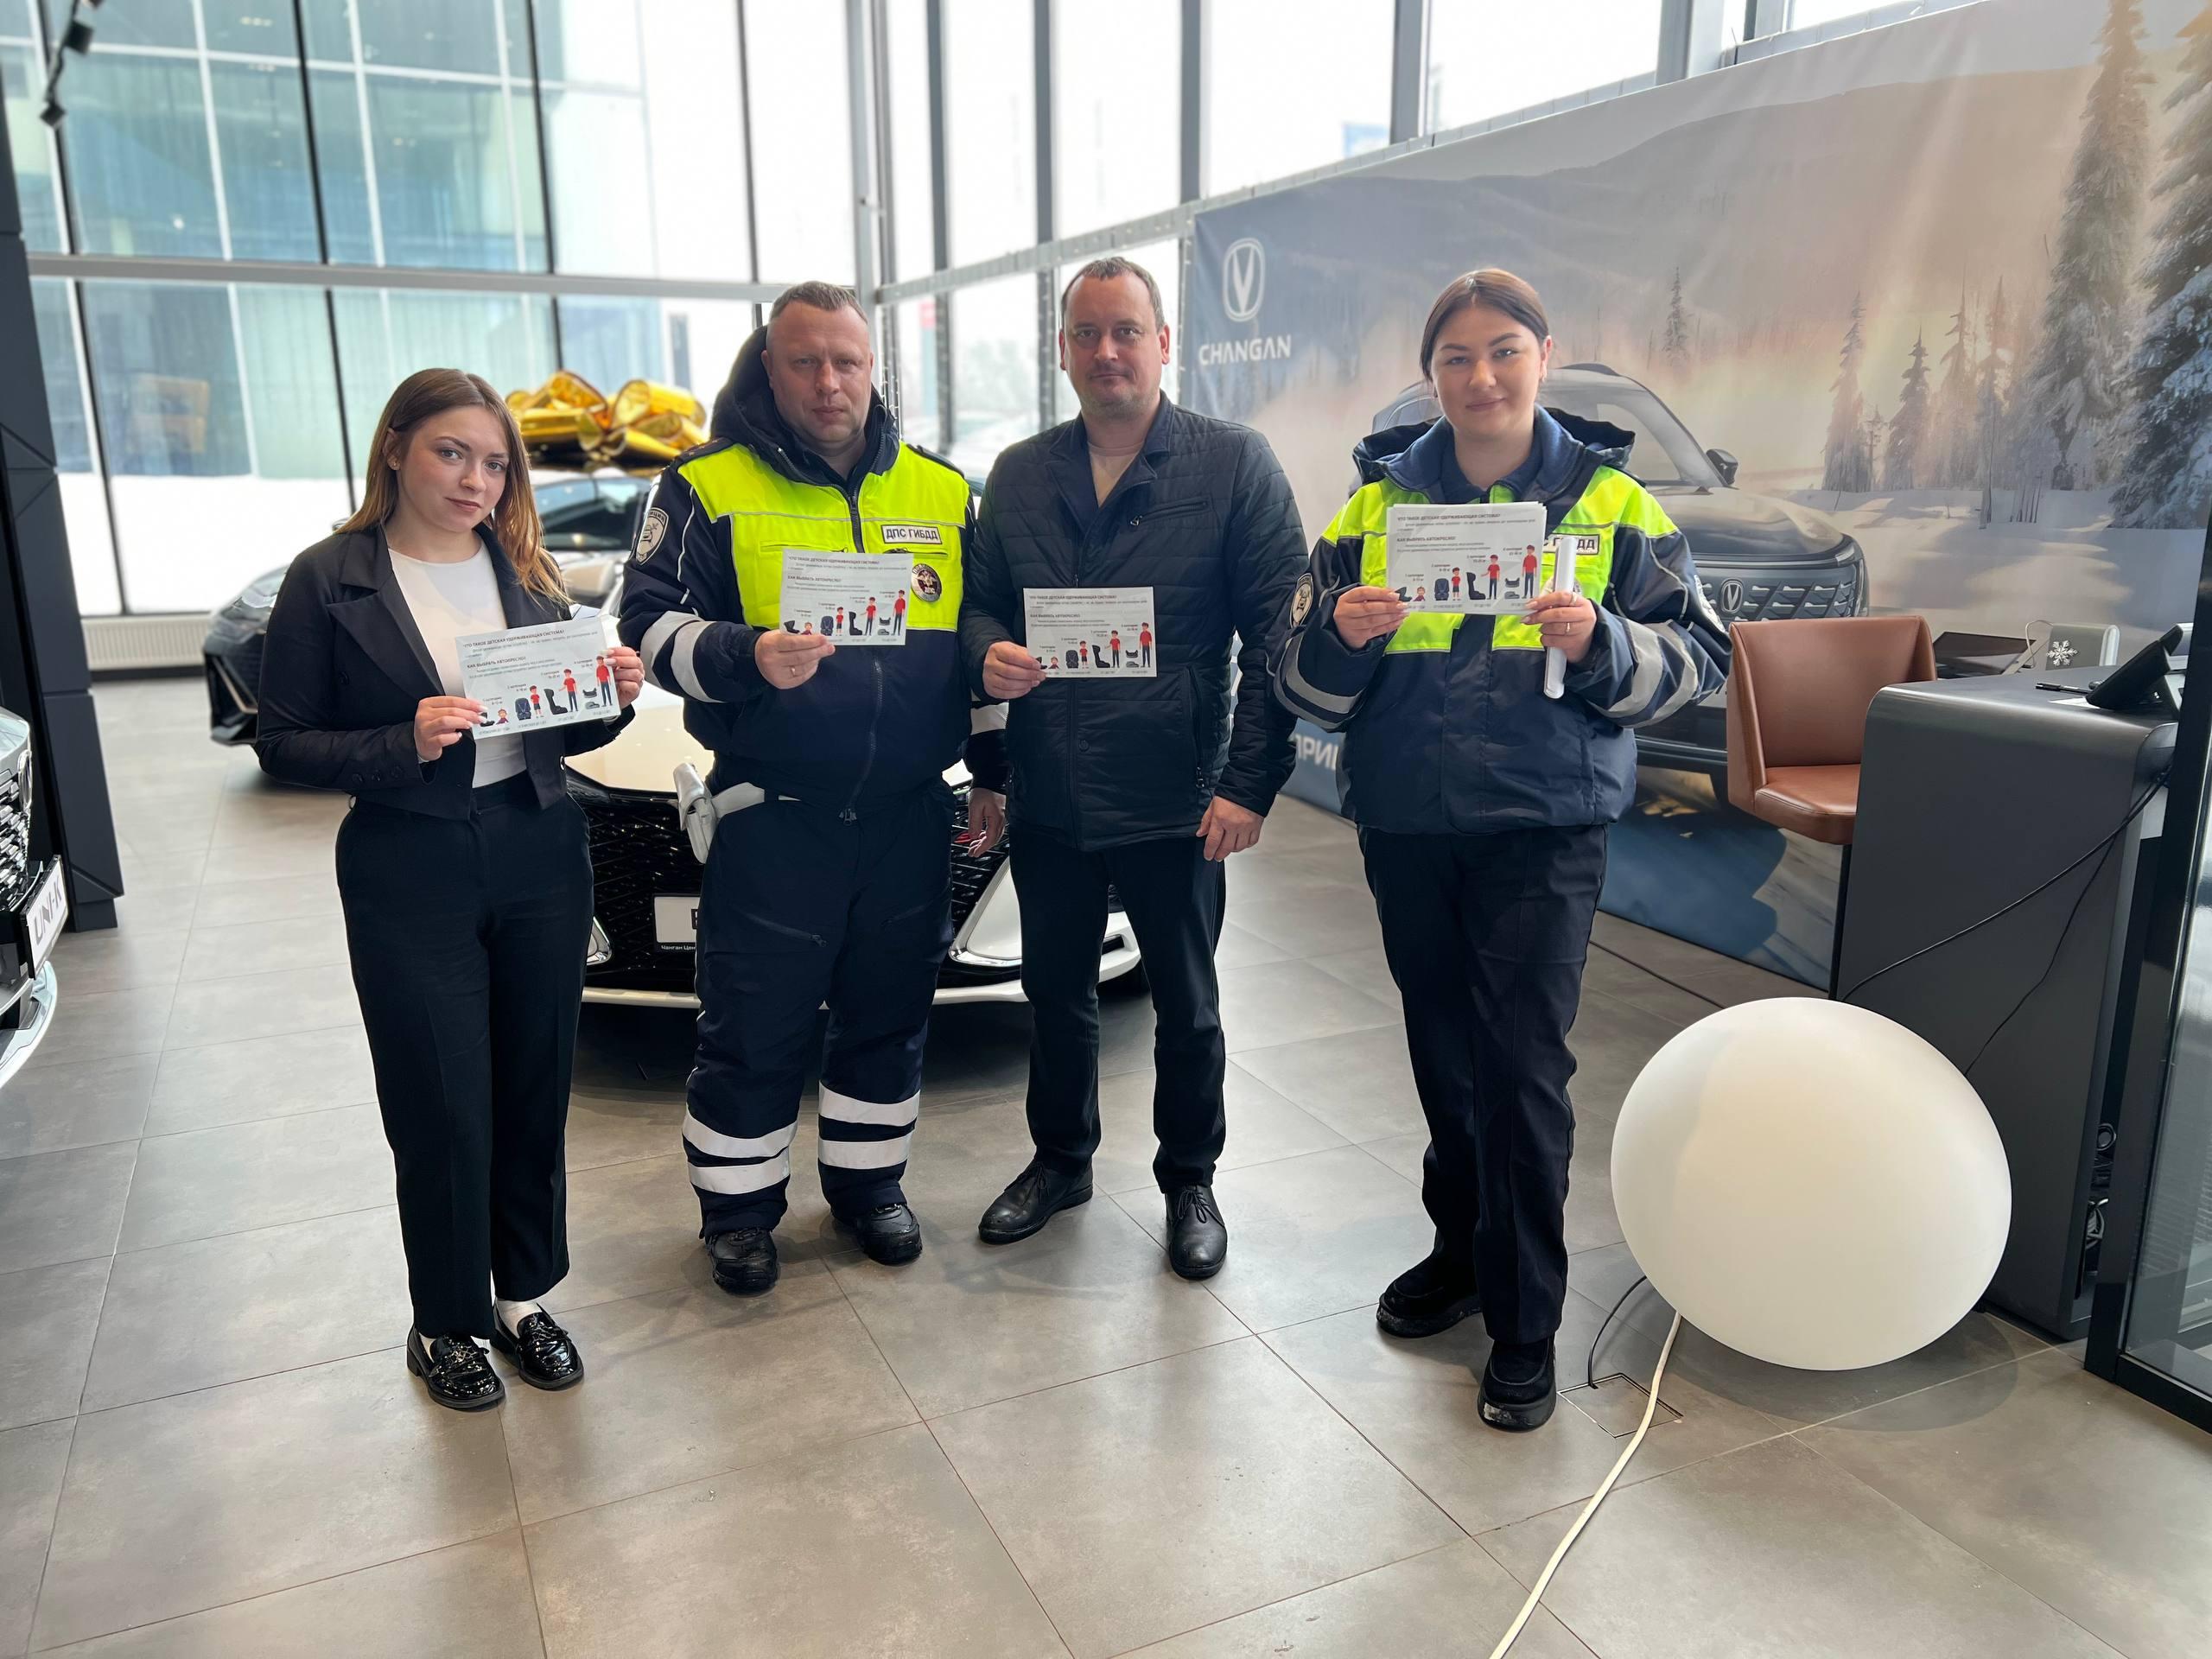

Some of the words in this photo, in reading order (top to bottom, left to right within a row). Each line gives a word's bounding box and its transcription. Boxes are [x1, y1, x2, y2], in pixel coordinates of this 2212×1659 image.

[1198, 334, 1292, 366] CHANGAN
[886, 529, 906, 540] ДПС
[908, 529, 938, 540] ГИБДД
[34, 874, 63, 946] UNI-K
